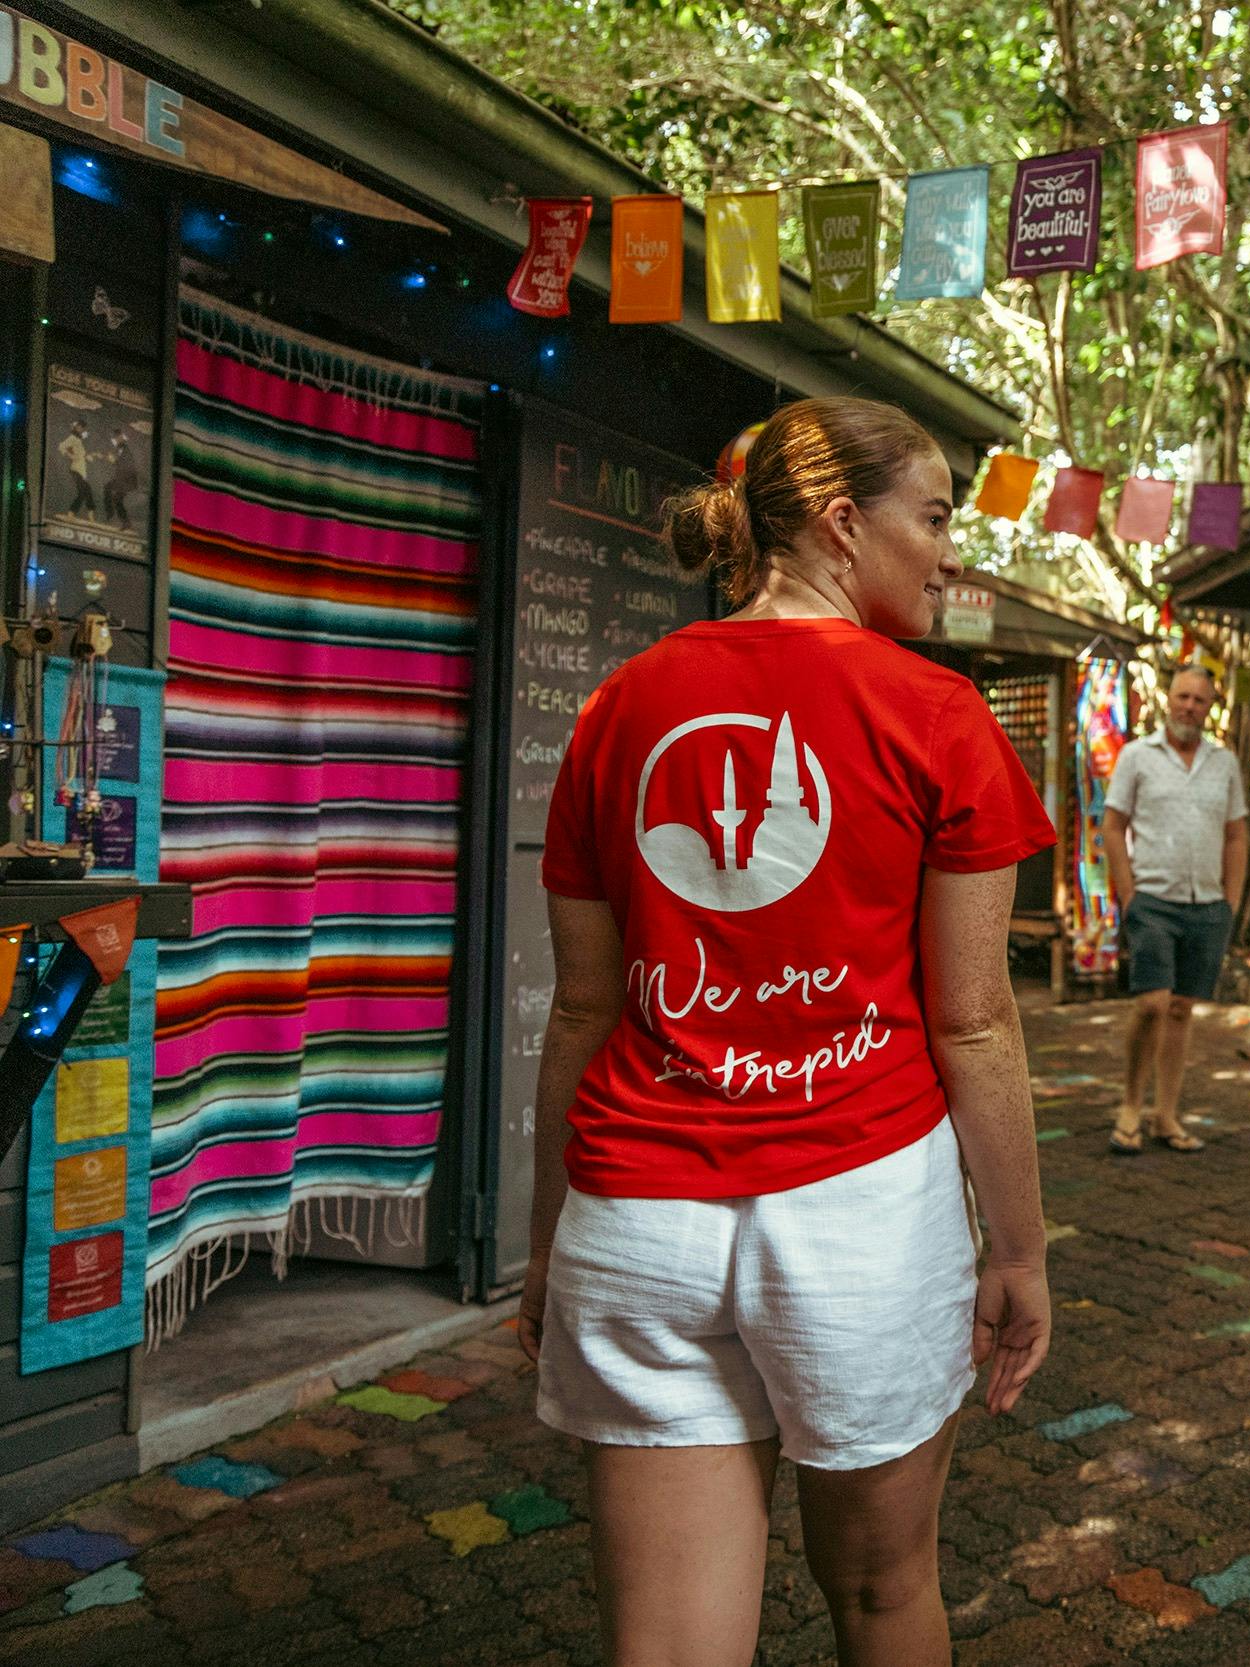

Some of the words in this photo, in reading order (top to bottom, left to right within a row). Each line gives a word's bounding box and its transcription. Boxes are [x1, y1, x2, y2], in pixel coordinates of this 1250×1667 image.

[1024, 190, 1055, 217] you
[1057, 188, 1086, 206] are
[822, 215, 861, 240] ever
[625, 232, 670, 258] believe
[815, 235, 868, 272] blessed
[530, 567, 593, 604] GRAPE
[527, 603, 590, 636] MANGO
[523, 641, 590, 672] LYCHEE
[628, 937, 741, 1032] We
[756, 964, 849, 1005] are
